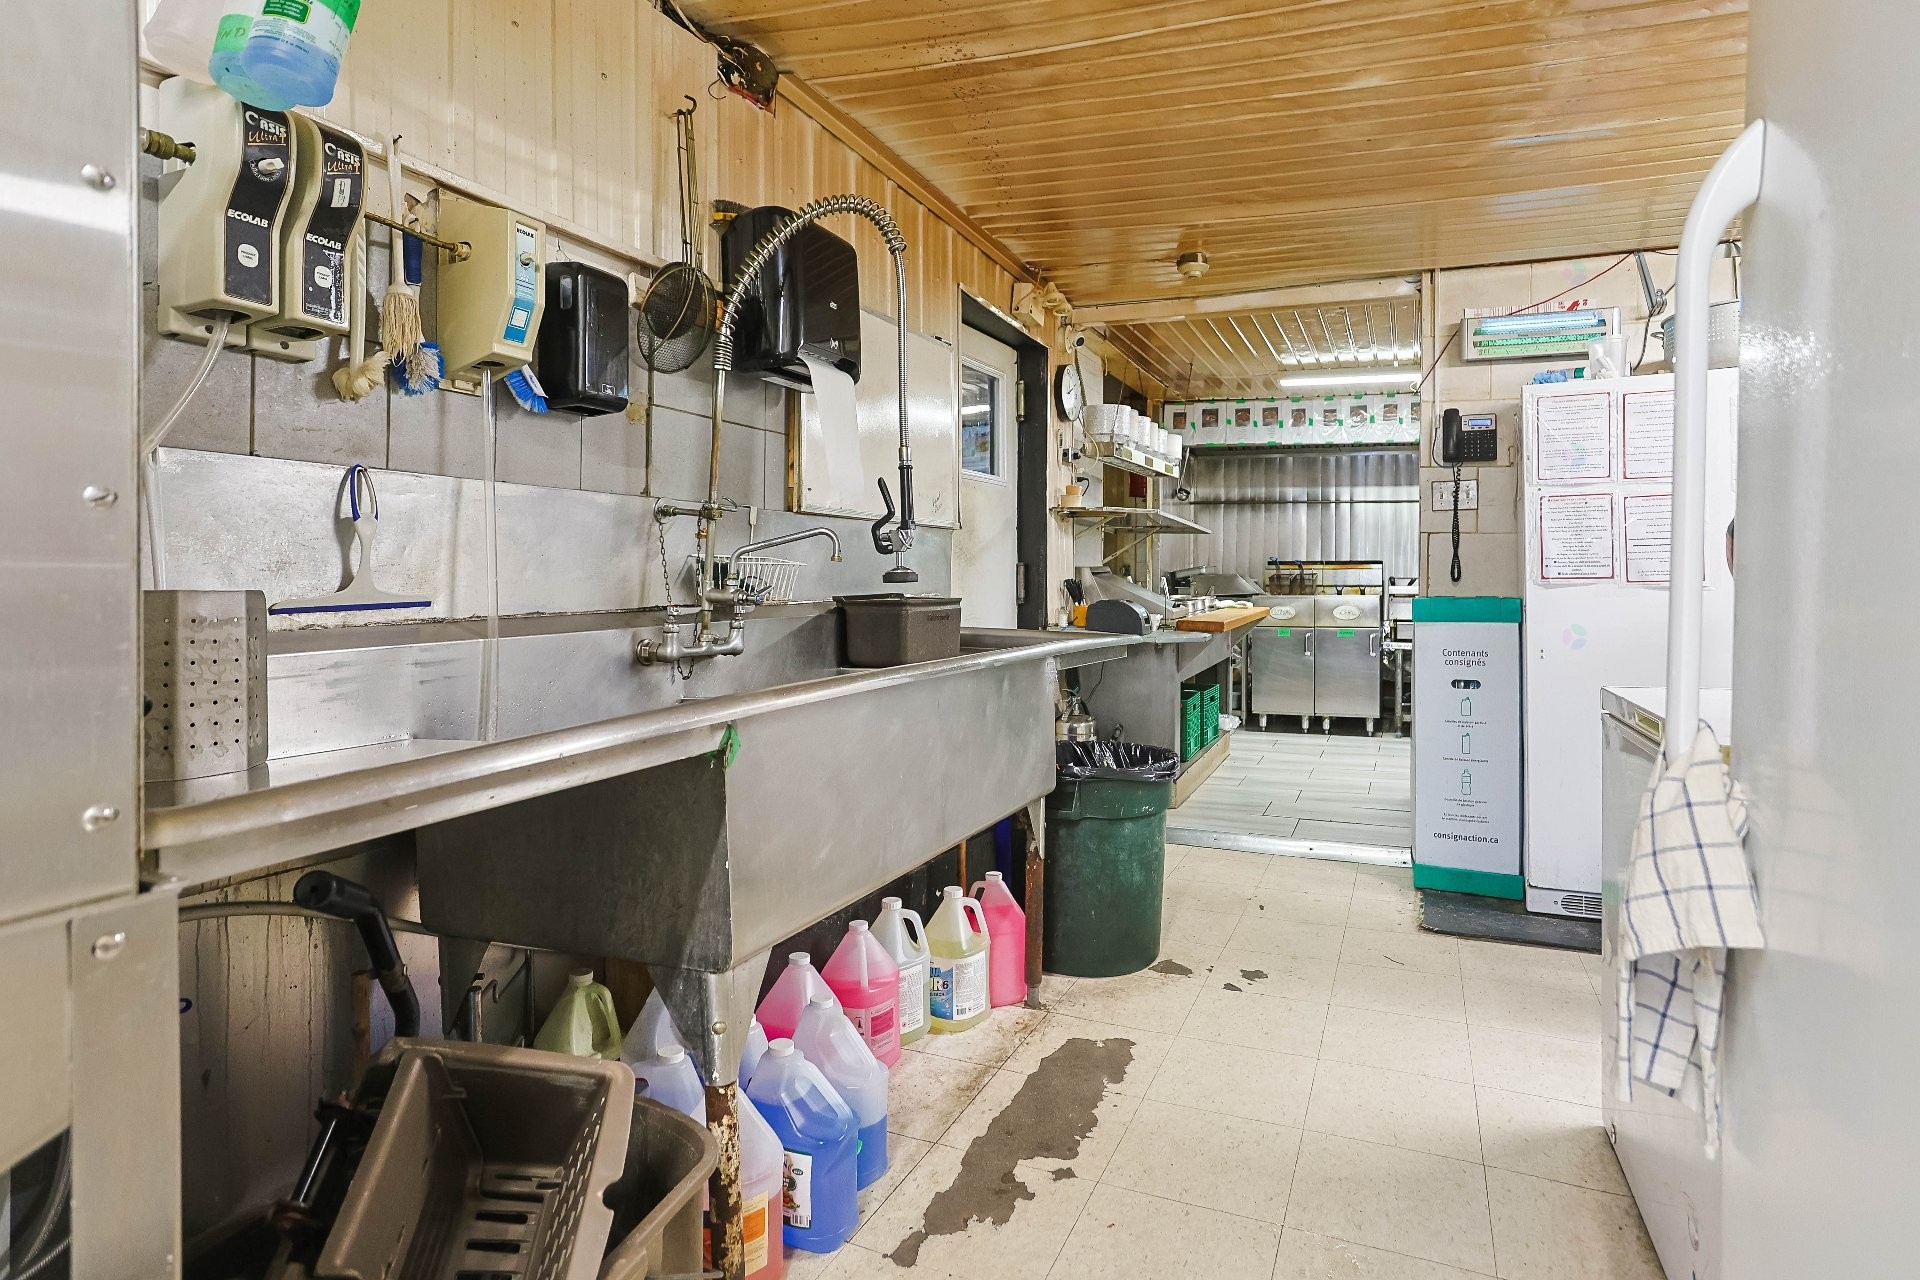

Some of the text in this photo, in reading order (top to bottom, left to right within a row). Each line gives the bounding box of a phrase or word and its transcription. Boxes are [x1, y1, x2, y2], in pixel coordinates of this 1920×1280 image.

[227, 208, 269, 228] ECOLAB
[305, 233, 342, 250] ECOLAB
[1442, 648, 1489, 658] Contenants
[1444, 657, 1486, 667] consignés
[1433, 832, 1499, 844] consignaction.ca
